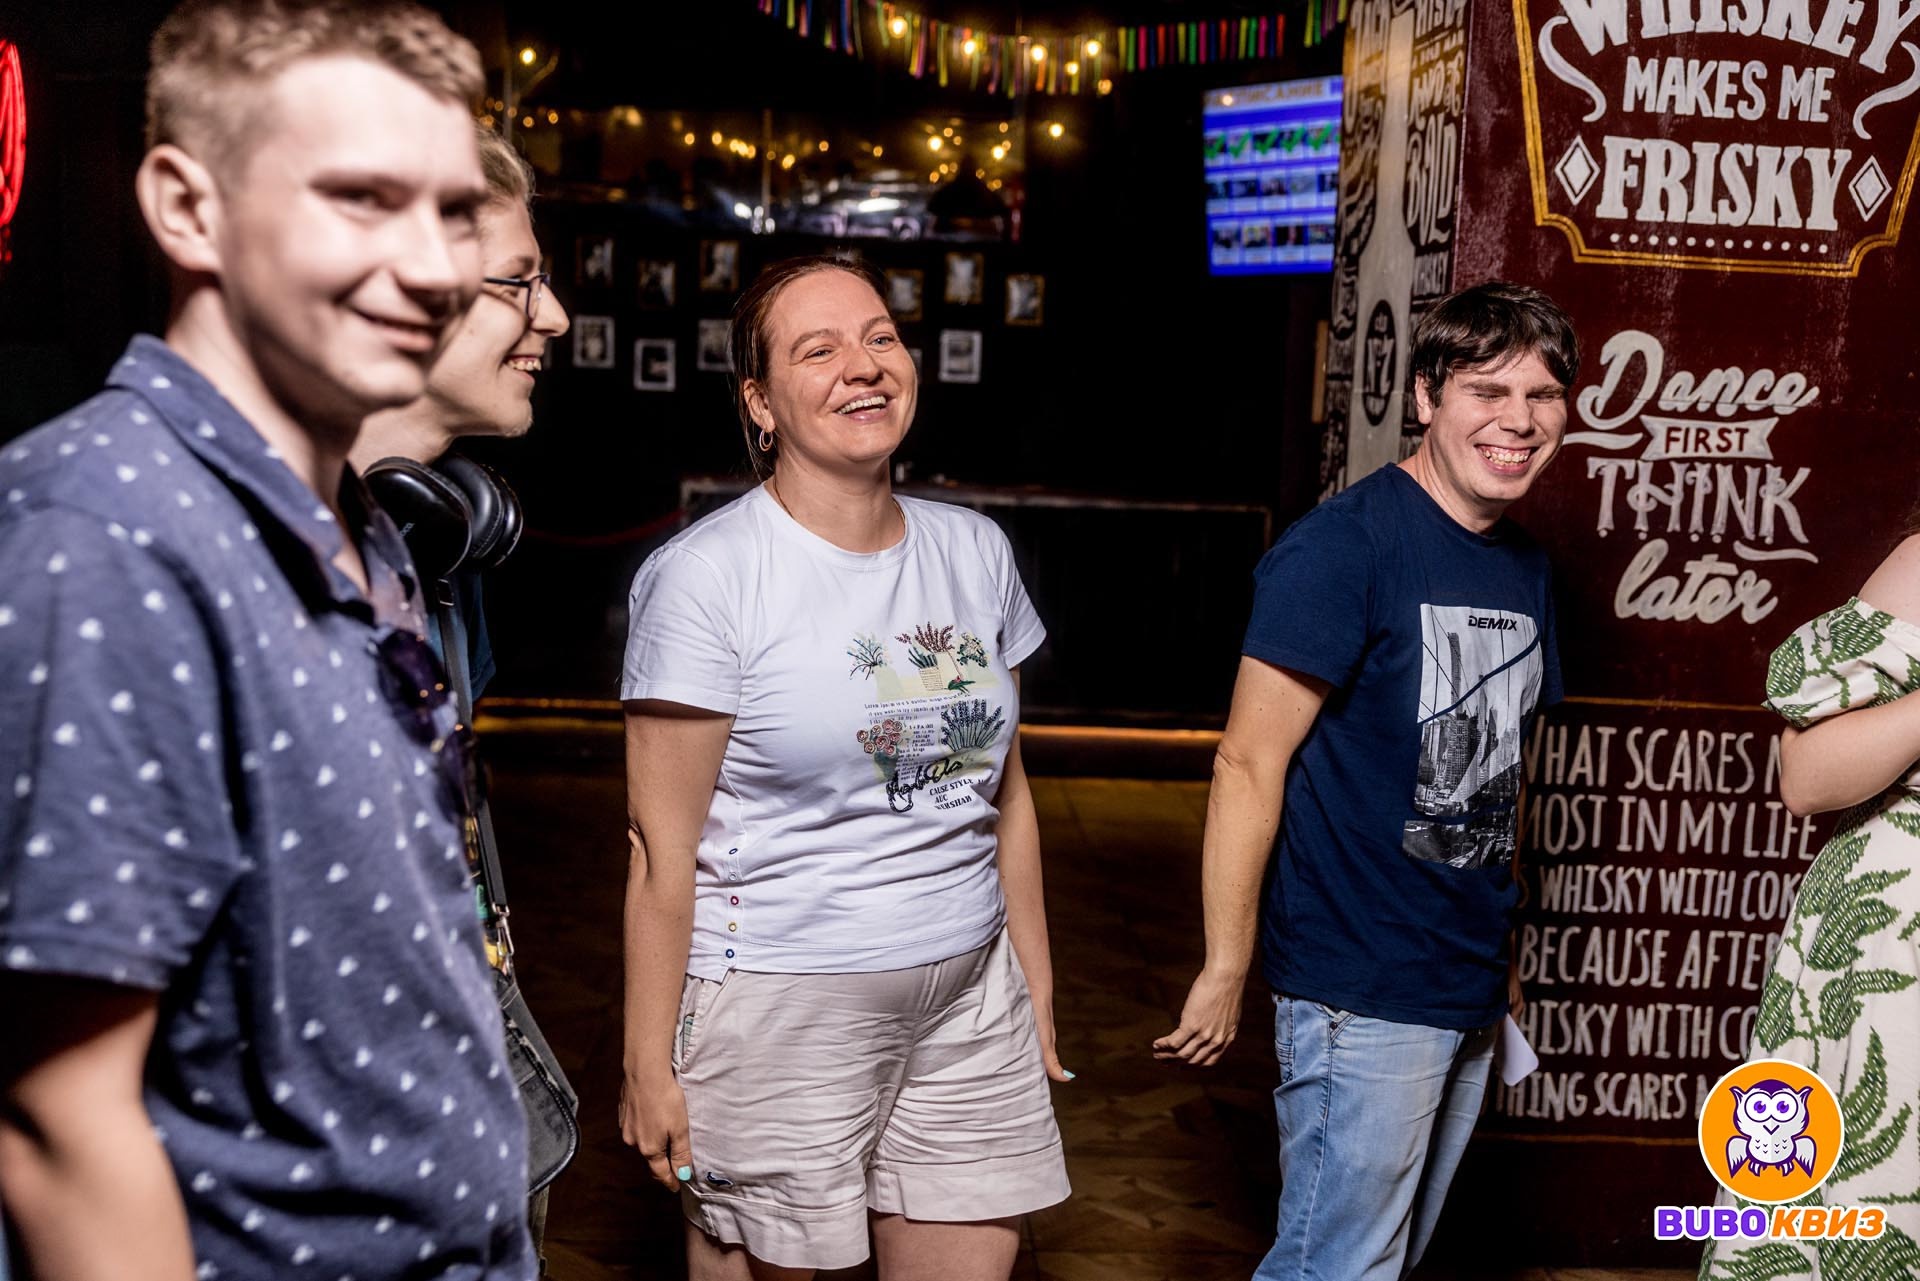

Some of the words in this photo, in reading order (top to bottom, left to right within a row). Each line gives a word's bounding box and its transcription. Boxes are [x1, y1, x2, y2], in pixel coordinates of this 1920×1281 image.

[1622, 55, 1768, 121] MAKES
[1777, 64, 1836, 123] ME
[1595, 135, 1853, 231] FRISKY
[1576, 329, 1820, 430] Dance
[1664, 426, 1750, 453] FIRST
[1587, 456, 1812, 544] THINK
[1614, 538, 1778, 625] later
[1468, 615, 1517, 631] DEMIX
[1624, 726, 1755, 794] SCARES
[1617, 796, 1668, 855] IN
[1677, 802, 1737, 856] MY
[1743, 802, 1818, 861] LIFE
[1538, 864, 1653, 914] WHISKY
[1658, 868, 1736, 920] WITH
[1740, 870, 1801, 922] COK
[1518, 923, 1671, 988] BECAUSE
[1519, 999, 1618, 1058] HISKY
[1626, 1002, 1714, 1059] WITH
[1593, 1071, 1689, 1122] SCARES
